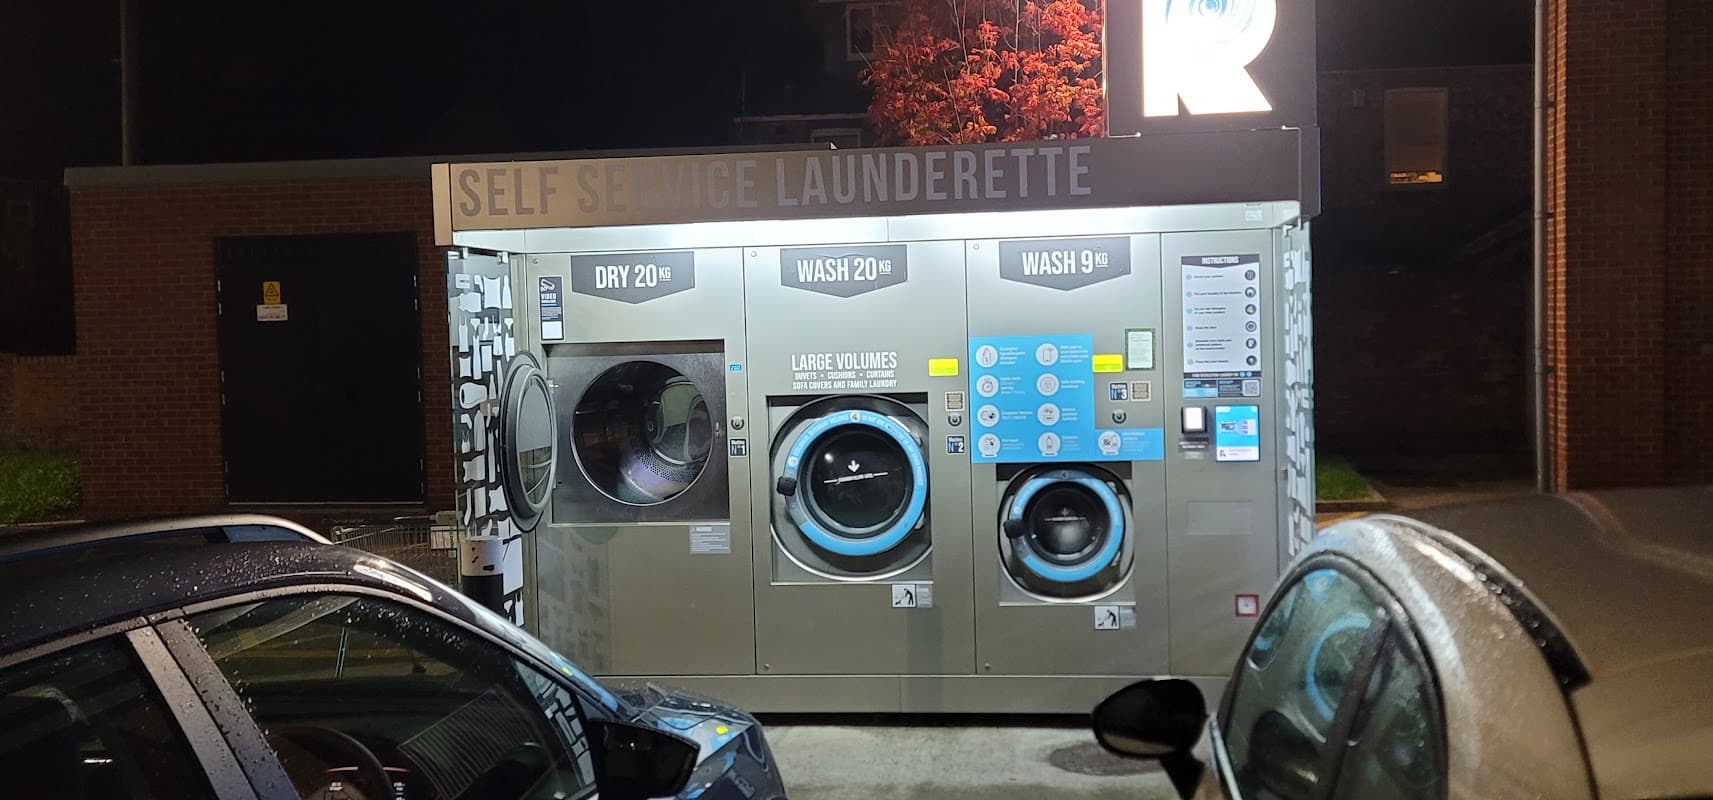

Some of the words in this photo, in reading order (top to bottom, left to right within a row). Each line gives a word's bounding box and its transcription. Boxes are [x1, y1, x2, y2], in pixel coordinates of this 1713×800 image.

[1142, 0, 1277, 117] R
[458, 166, 559, 217] SELF
[576, 159, 759, 215] SEVICE
[775, 145, 1092, 207] LAUNDERETTE
[796, 257, 849, 283] WASH
[1021, 249, 1076, 276] WASH
[1080, 249, 1094, 274] 9
[595, 264, 630, 289] DRY
[791, 352, 834, 371] LARGE
[835, 351, 898, 370] VOLUMES
[792, 381, 808, 390] SOFA
[808, 381, 833, 390] COVERS
[833, 380, 846, 389] AND
[846, 379, 868, 389] FAMILY
[869, 379, 897, 388] LAUNDRY
[794, 371, 818, 381] DUVETS
[827, 370, 857, 380] CUSHIONS
[866, 369, 895, 379] CURTAINS
